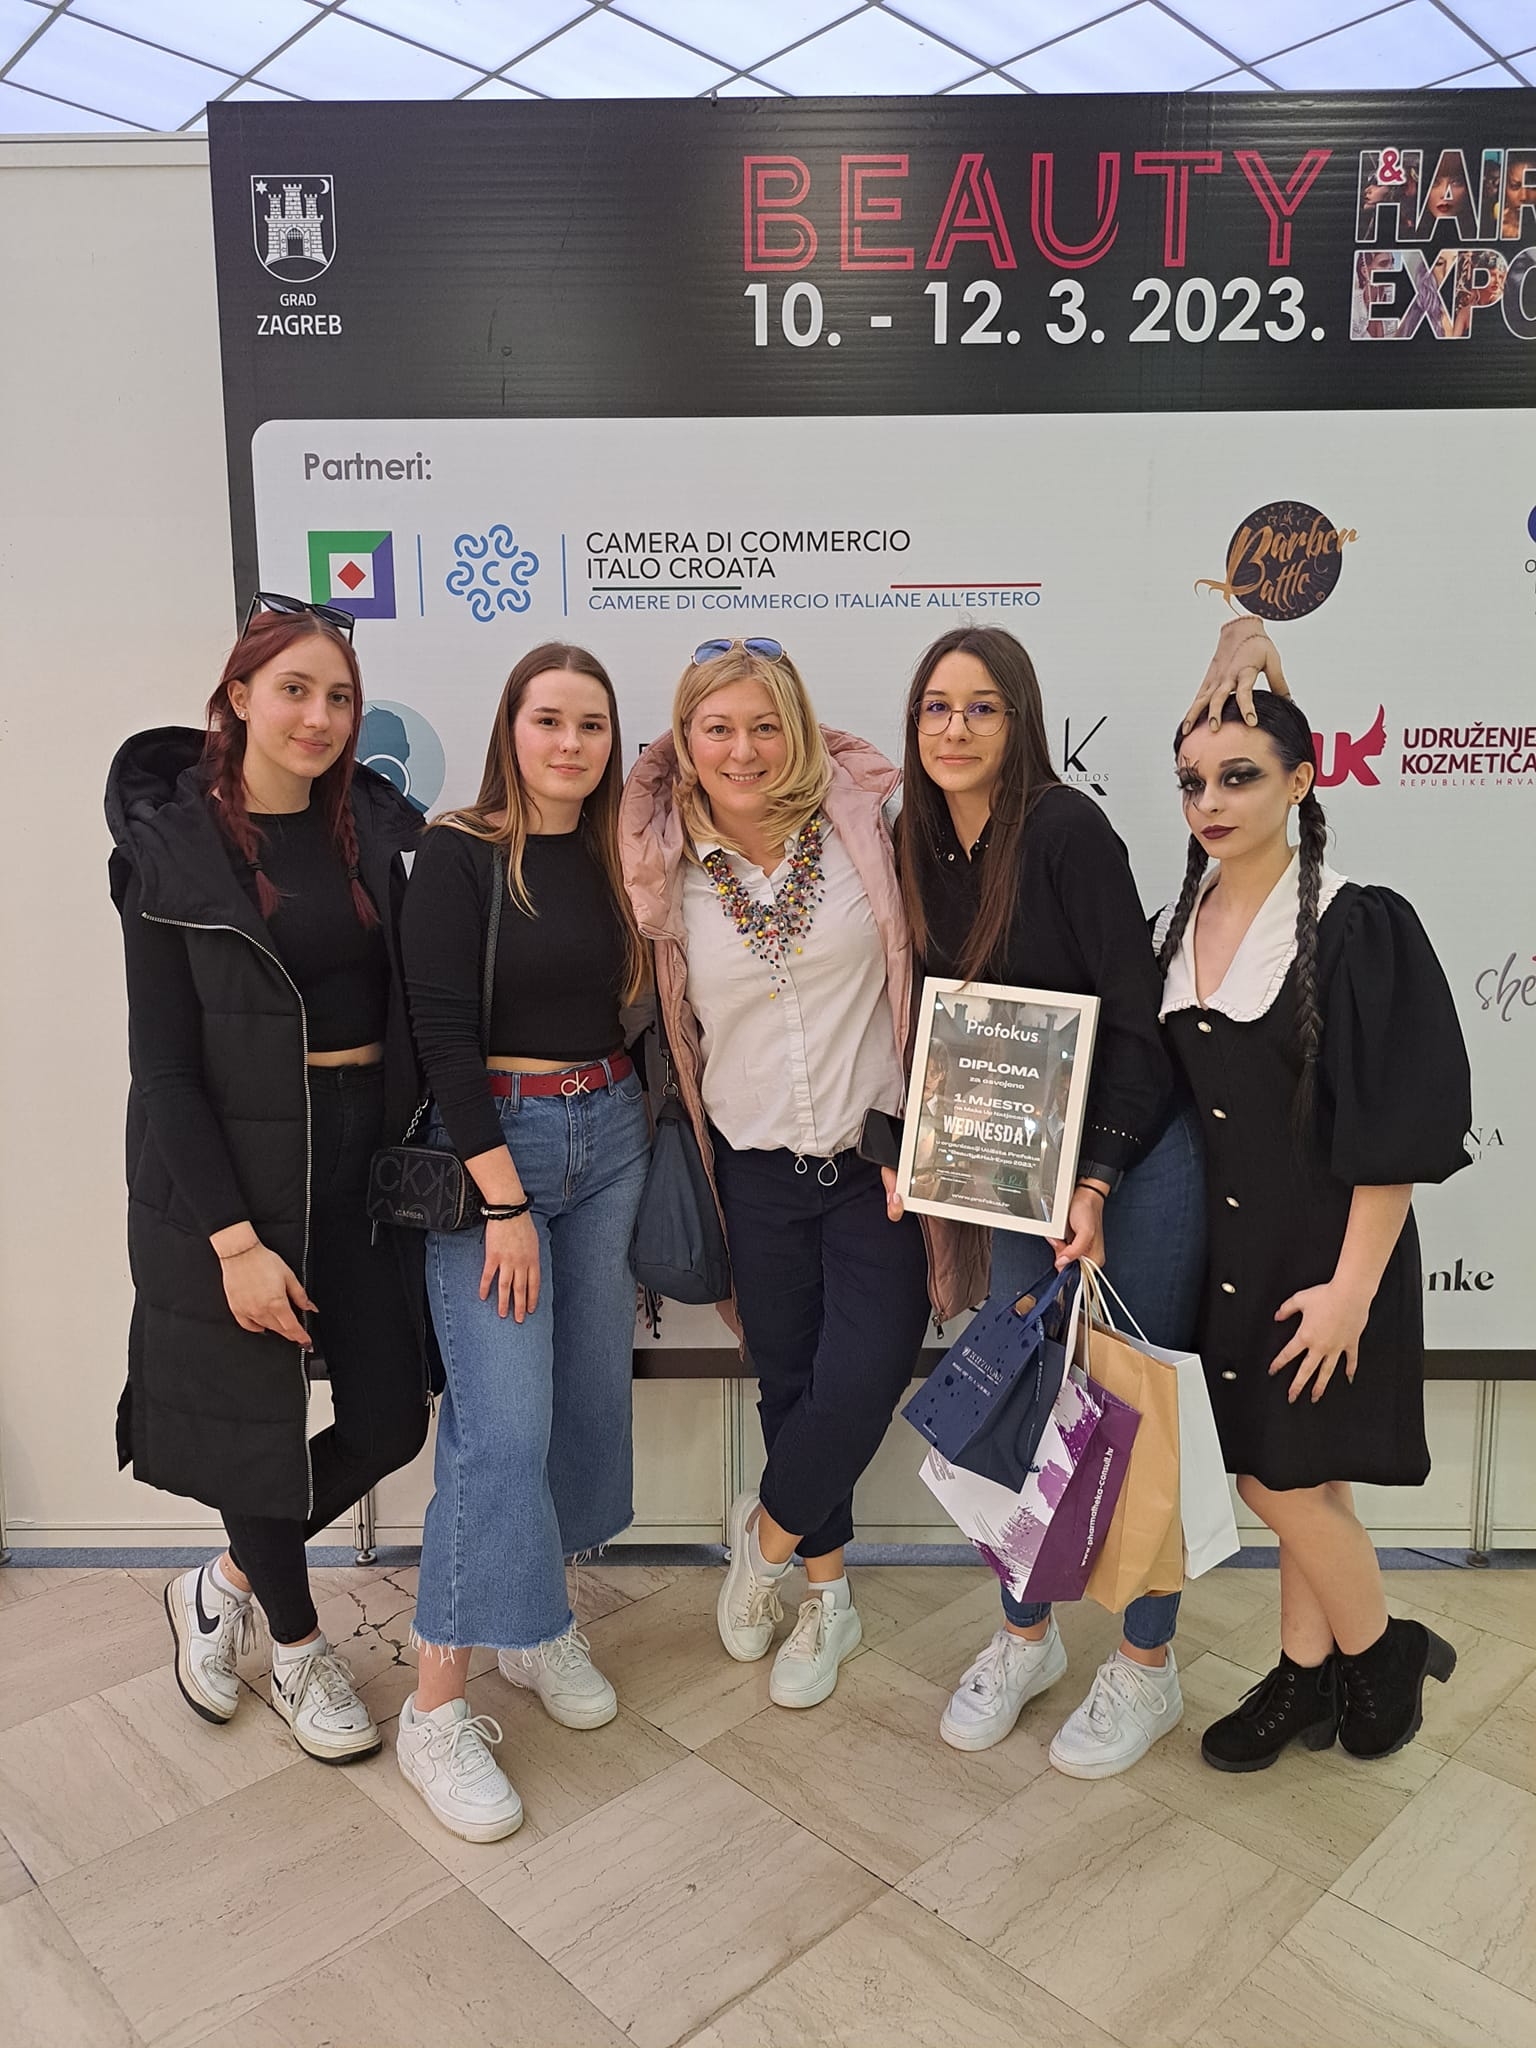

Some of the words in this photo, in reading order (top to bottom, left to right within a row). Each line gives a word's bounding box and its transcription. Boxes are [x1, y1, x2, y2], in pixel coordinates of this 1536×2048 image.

[1355, 149, 1536, 243] HAIR
[744, 150, 1333, 272] BEAUTY
[279, 293, 317, 306] GRAD
[1350, 247, 1536, 340] EXPO
[744, 282, 842, 347] 10.
[924, 279, 1021, 344] 12.
[1045, 279, 1105, 344] 3.
[1129, 276, 1325, 343] 2023.
[257, 314, 343, 335] ZAGREB
[304, 452, 432, 480] Partneri:
[586, 532, 699, 553] CAMERA
[707, 532, 731, 552] DI
[741, 530, 911, 552] COMMERCIO
[588, 558, 661, 579] ITALO
[669, 557, 776, 579] CROATA
[588, 595, 671, 609] CAMERE
[677, 595, 695, 609] DI
[702, 594, 829, 609] COMMERCIO
[835, 593, 921, 608] ITALIANE
[1404, 722, 1536, 751] UDRUŽENJE
[1059, 773, 1110, 782] ALLOS
[1400, 779, 1486, 787] REPUBLIKE
[959, 1058, 1040, 1079] DIPLOMA
[954, 1093, 967, 1103] 1.
[968, 1095, 1035, 1114] MJESTO
[943, 1115, 1036, 1147] WEDNESDAY
[1422, 1258, 1495, 1291] nke
[1080, 1446, 1114, 1567] www.pharmatheka-consult.hr
